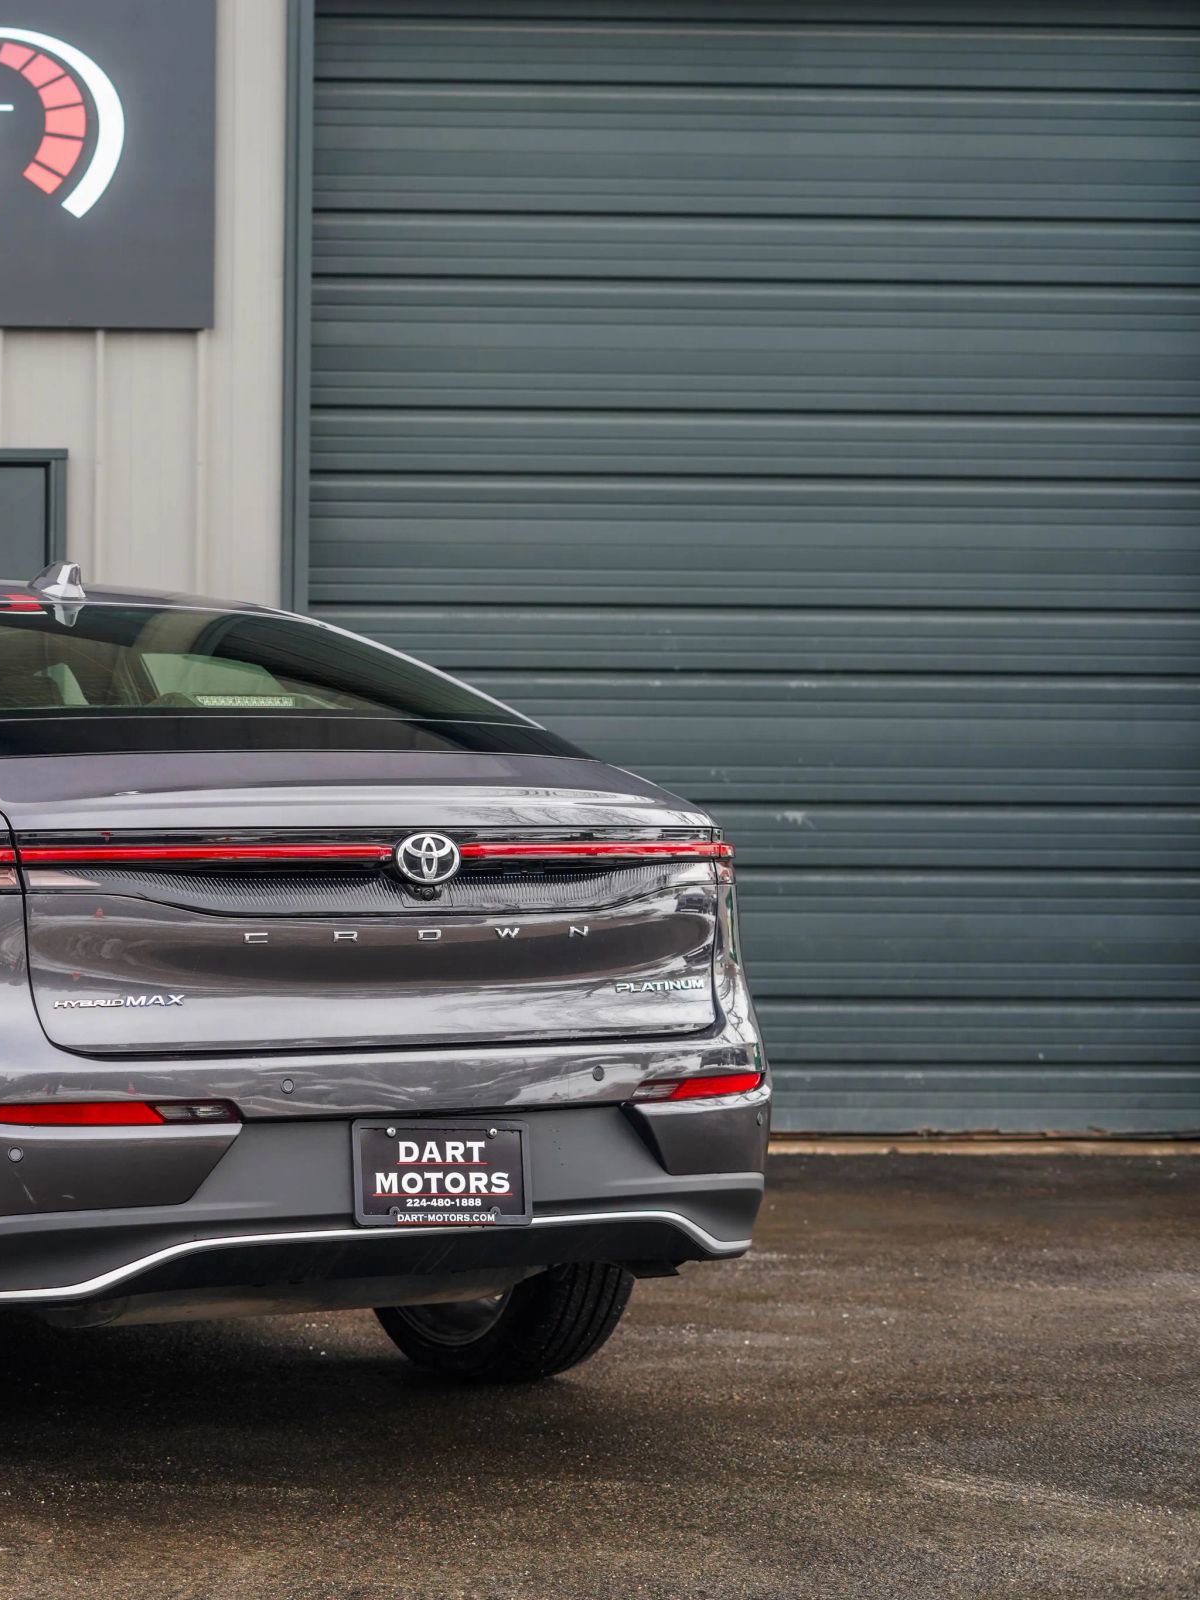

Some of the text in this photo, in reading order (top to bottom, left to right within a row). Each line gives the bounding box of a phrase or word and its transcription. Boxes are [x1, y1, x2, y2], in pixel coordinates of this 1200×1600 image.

[243, 925, 589, 944] CROWN
[615, 979, 705, 993] PLATINUM
[398, 1140, 486, 1163] DART
[374, 1171, 510, 1194] MOTORS
[406, 1198, 482, 1207] 224-480-1888
[397, 1213, 495, 1222] DART-MOTORS.COM
